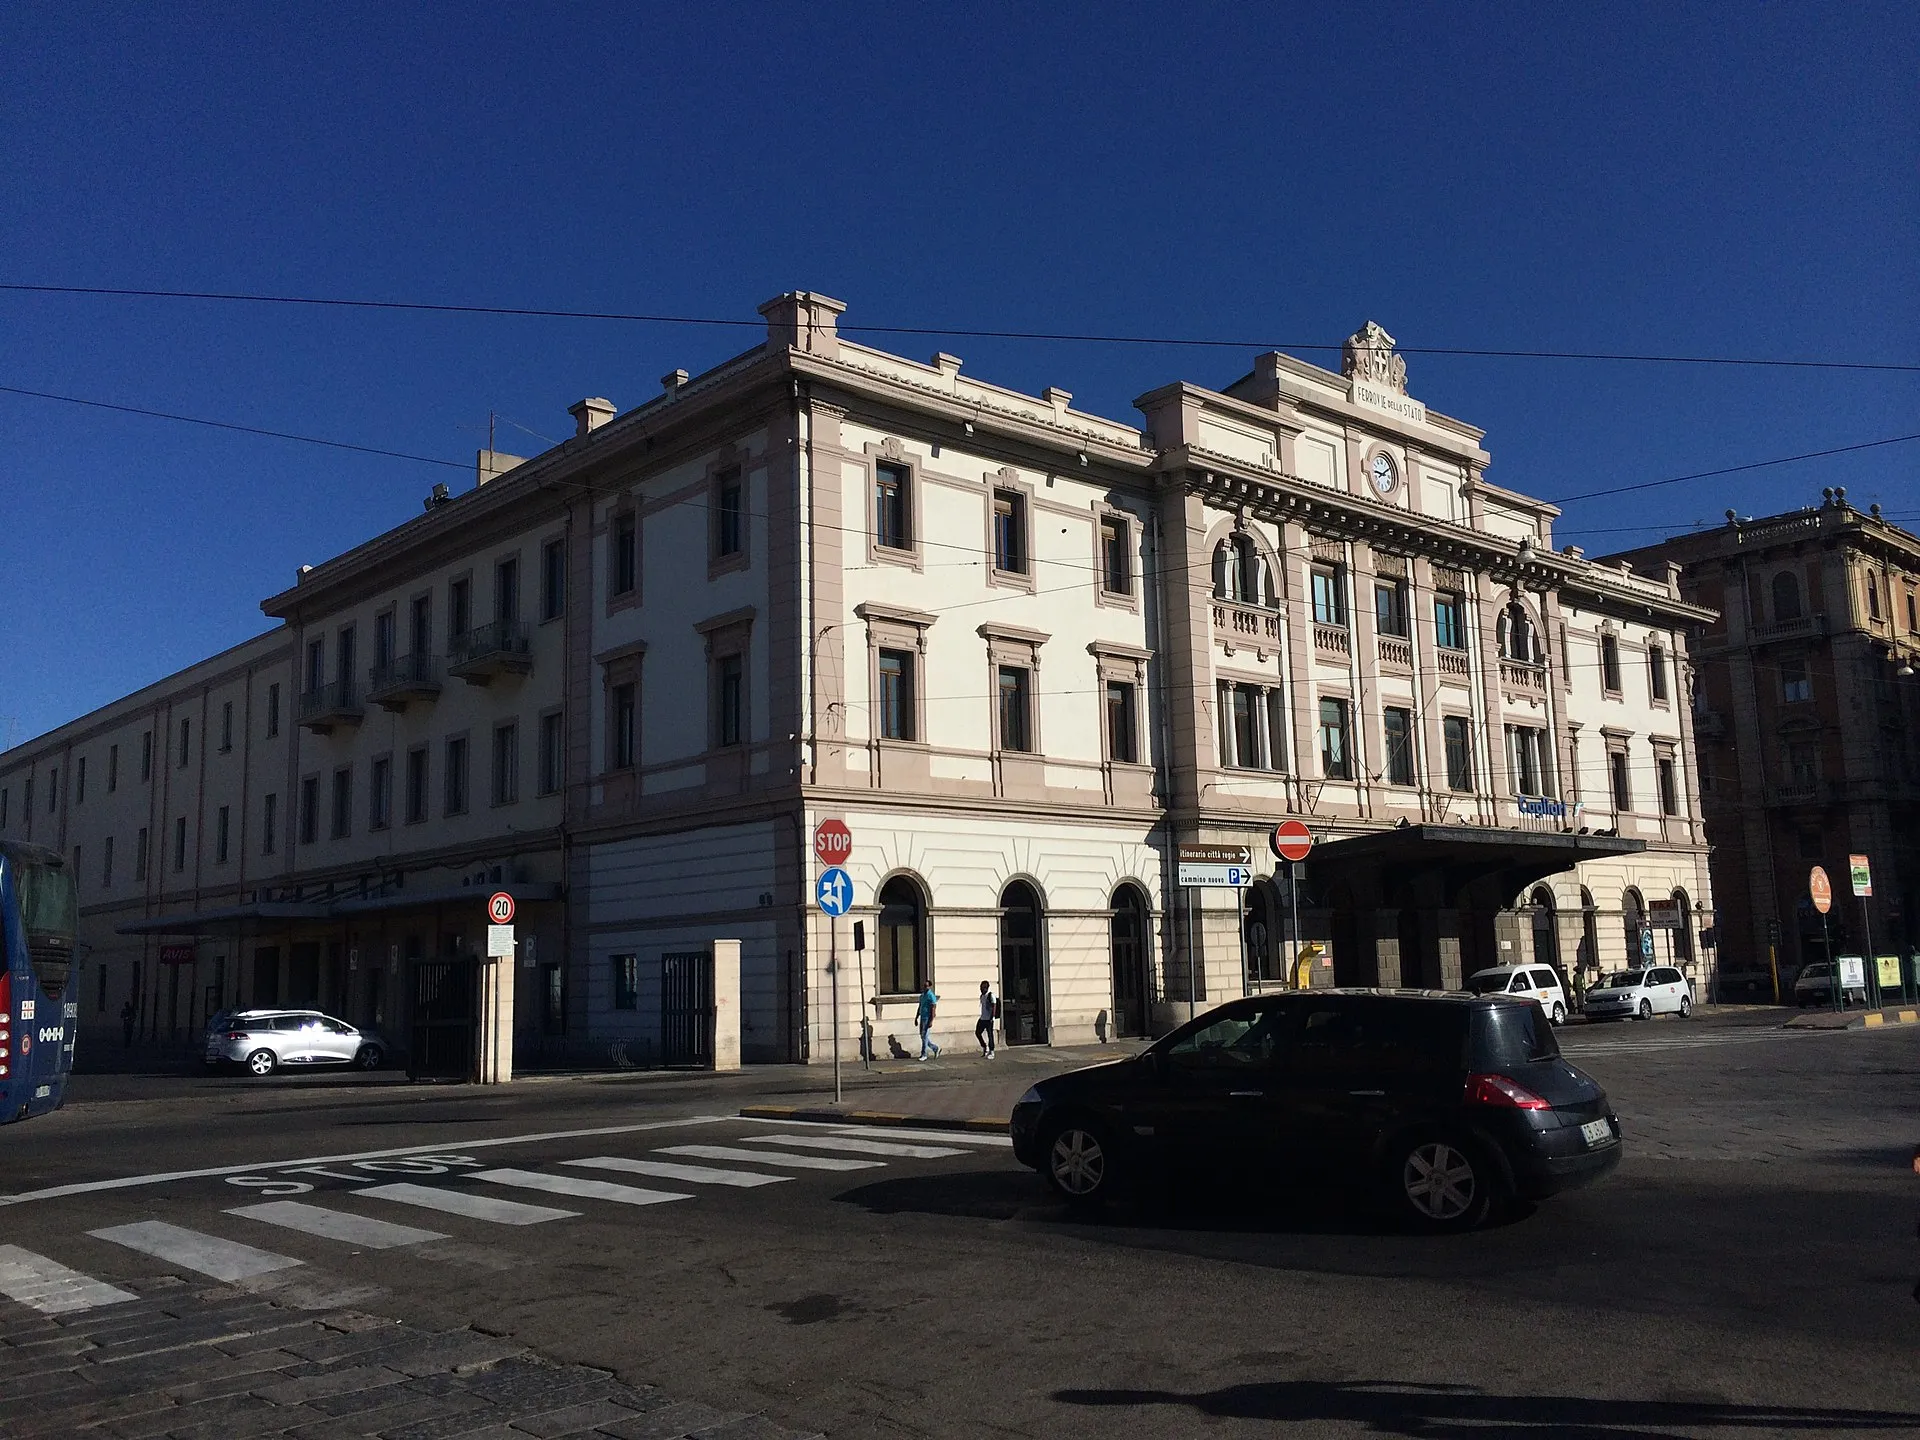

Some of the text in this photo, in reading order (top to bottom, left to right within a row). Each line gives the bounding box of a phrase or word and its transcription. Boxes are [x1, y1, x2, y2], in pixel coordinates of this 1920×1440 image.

[1358, 386, 1387, 410] FERROVIE
[1403, 403, 1422, 422] STATO
[1518, 796, 1567, 818] Cagliari
[817, 833, 850, 852] STOP
[1231, 869, 1238, 883] P
[495, 900, 508, 916] 20
[163, 949, 191, 960] AVIS
[224, 1155, 486, 1195] STOP
